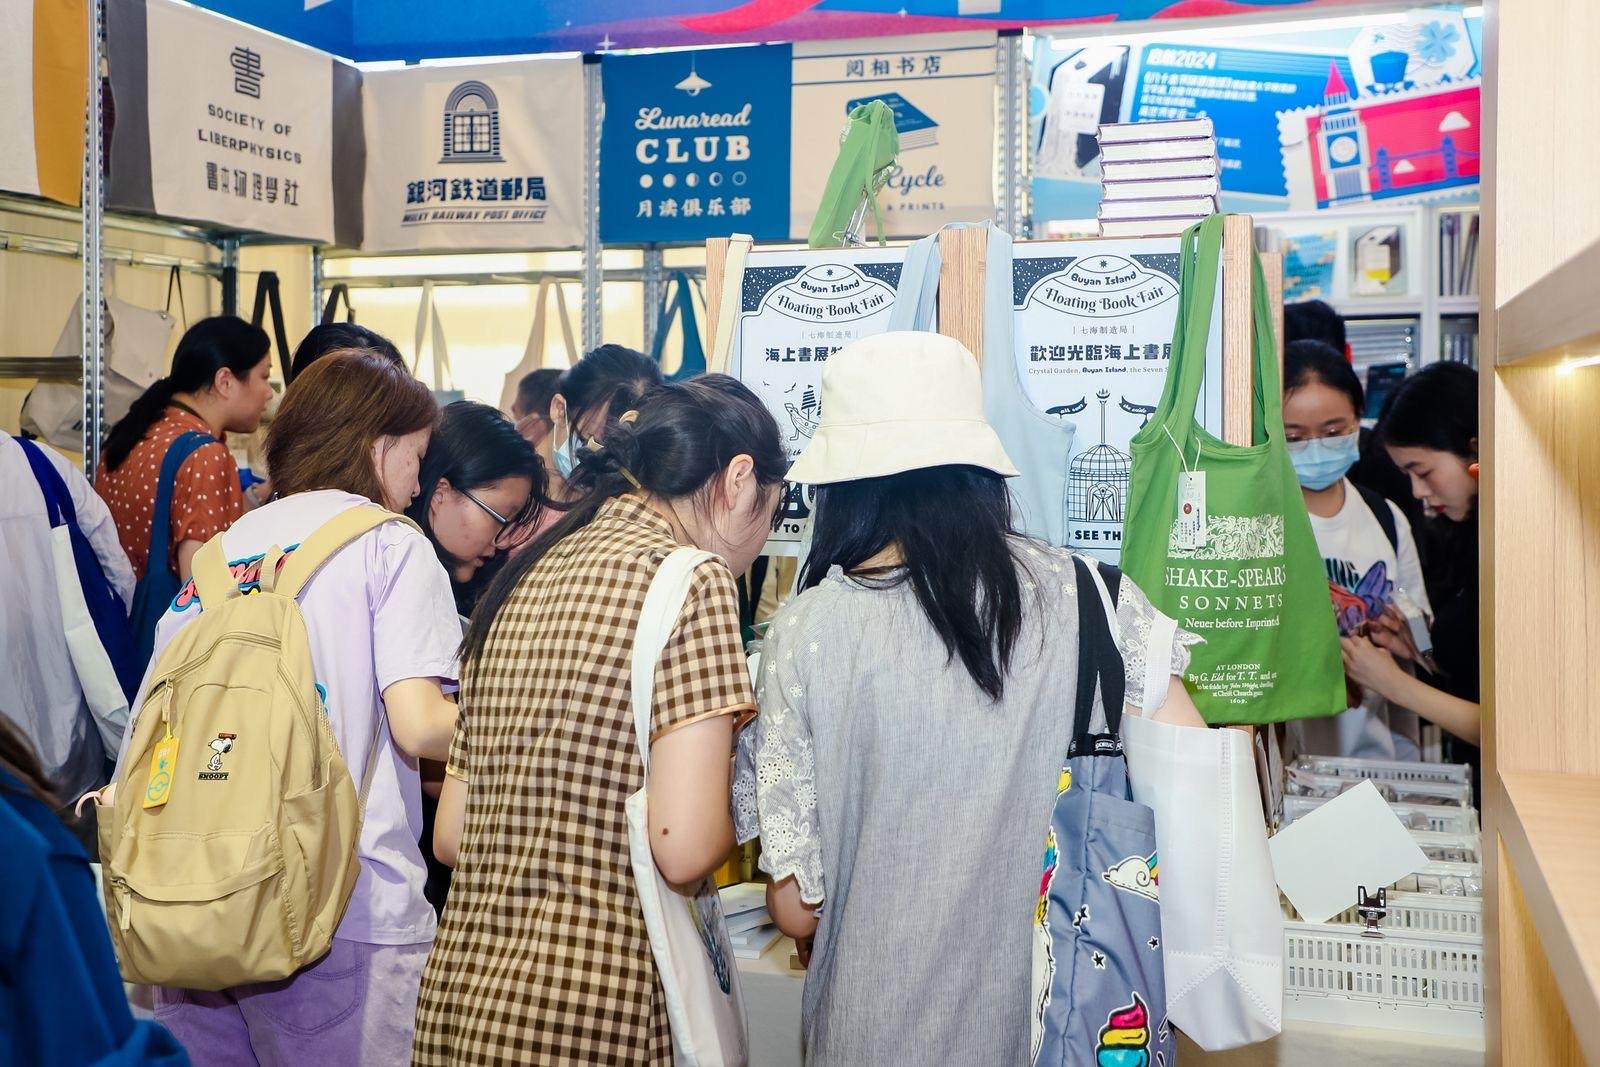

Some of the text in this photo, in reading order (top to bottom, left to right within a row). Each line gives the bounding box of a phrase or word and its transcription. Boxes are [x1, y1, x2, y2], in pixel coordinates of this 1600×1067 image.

[207, 103, 293, 137] SOCIETY OF
[634, 102, 753, 130] Lunaread
[197, 128, 303, 165] LIBERPHYSICS
[635, 134, 751, 164] CLUB
[887, 164, 946, 196] Cycle
[900, 201, 945, 211] PRINTS
[431, 210, 482, 221] RAILWAY
[482, 209, 509, 220] POST
[1070, 271, 1137, 286] Buyan Island
[800, 279, 860, 294] Buyan Island
[777, 293, 886, 319] Floating Book Fair
[1045, 286, 1164, 313] Floating Book Fair
[1082, 366, 1103, 374] Buyan
[783, 523, 800, 534] TO
[1074, 530, 1099, 540] SEE
[1179, 593, 1283, 611] SONNETS
[1215, 617, 1244, 629] before
[1227, 663, 1261, 671] LONDON
[1188, 673, 1199, 684] By
[1200, 672, 1209, 682] G.
[1226, 672, 1237, 681] for
[1237, 671, 1246, 681] T.
[1247, 671, 1257, 681] T.
[198, 771, 230, 781] SNOOPY
